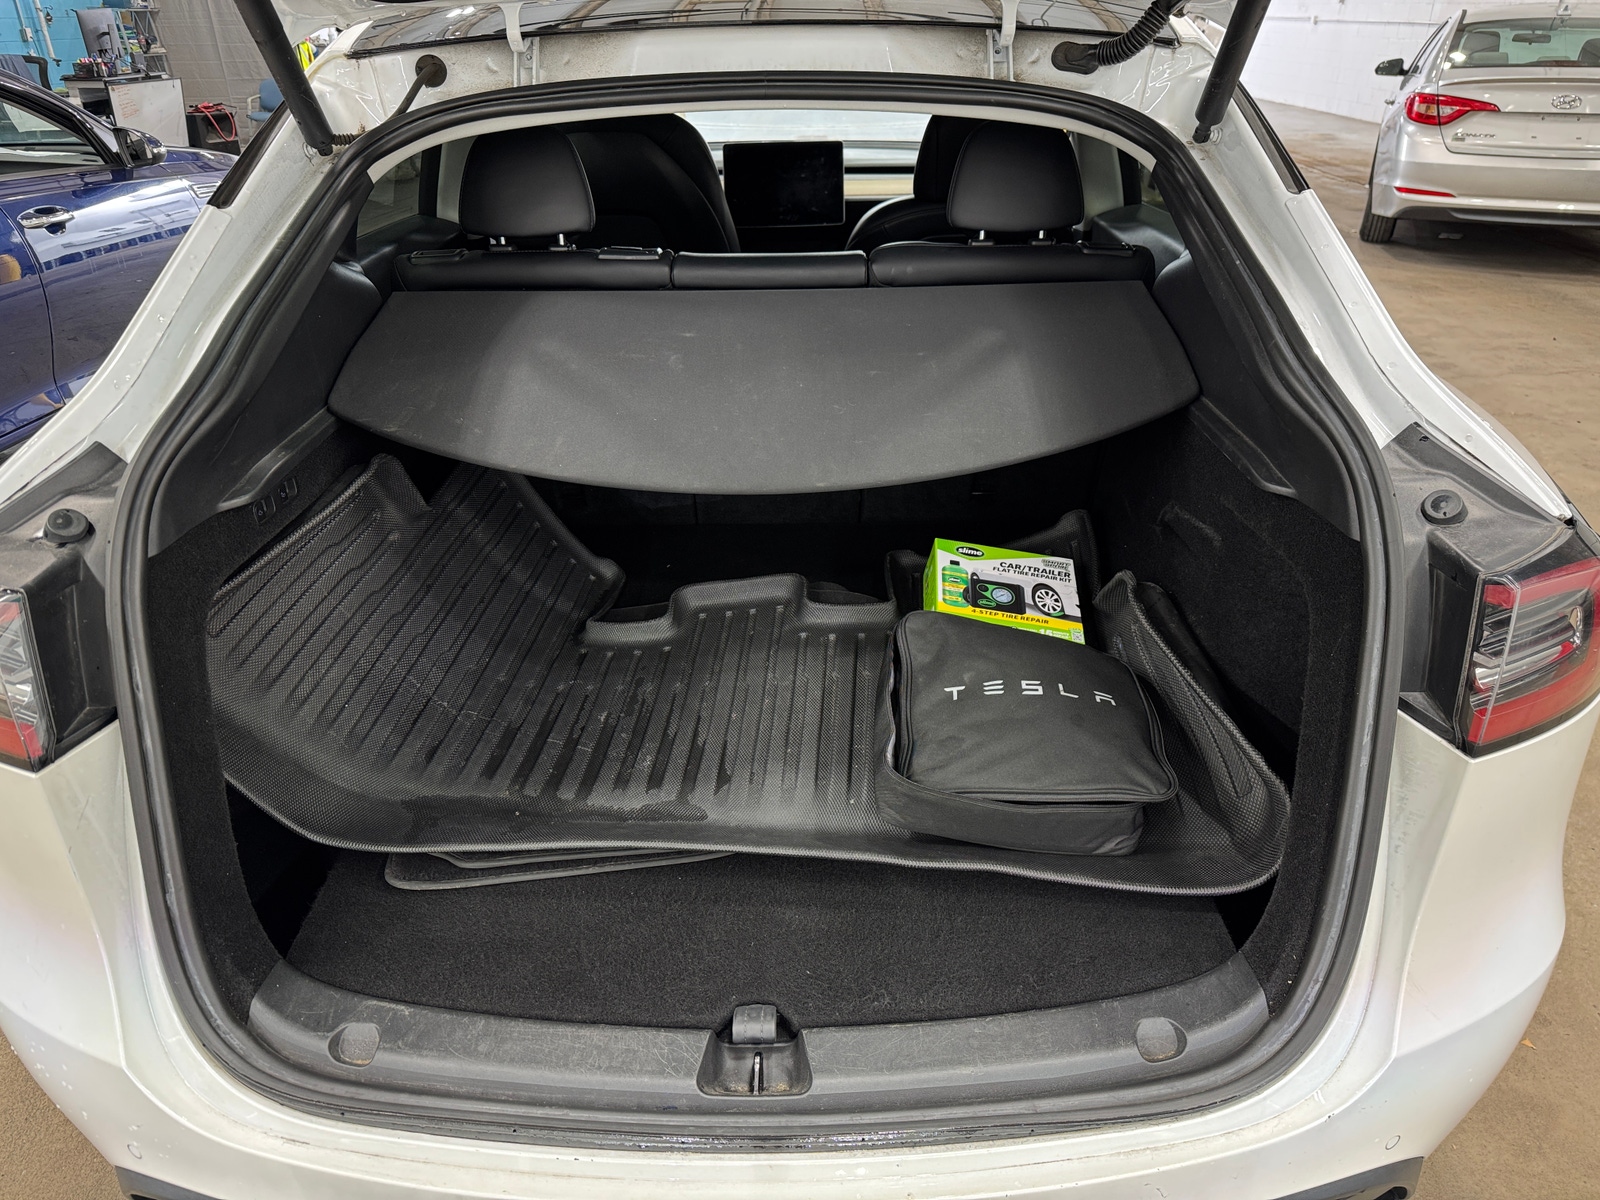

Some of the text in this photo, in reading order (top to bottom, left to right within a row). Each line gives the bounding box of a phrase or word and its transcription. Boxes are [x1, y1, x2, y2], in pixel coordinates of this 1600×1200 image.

[958, 547, 983, 556] slime
[993, 566, 1011, 574] FLAT
[1030, 572, 1058, 581] REPAIR
[999, 561, 1071, 578] CAR/TRAILER
[1020, 616, 1049, 625] REPAIR
[944, 679, 1117, 706] TESLA
